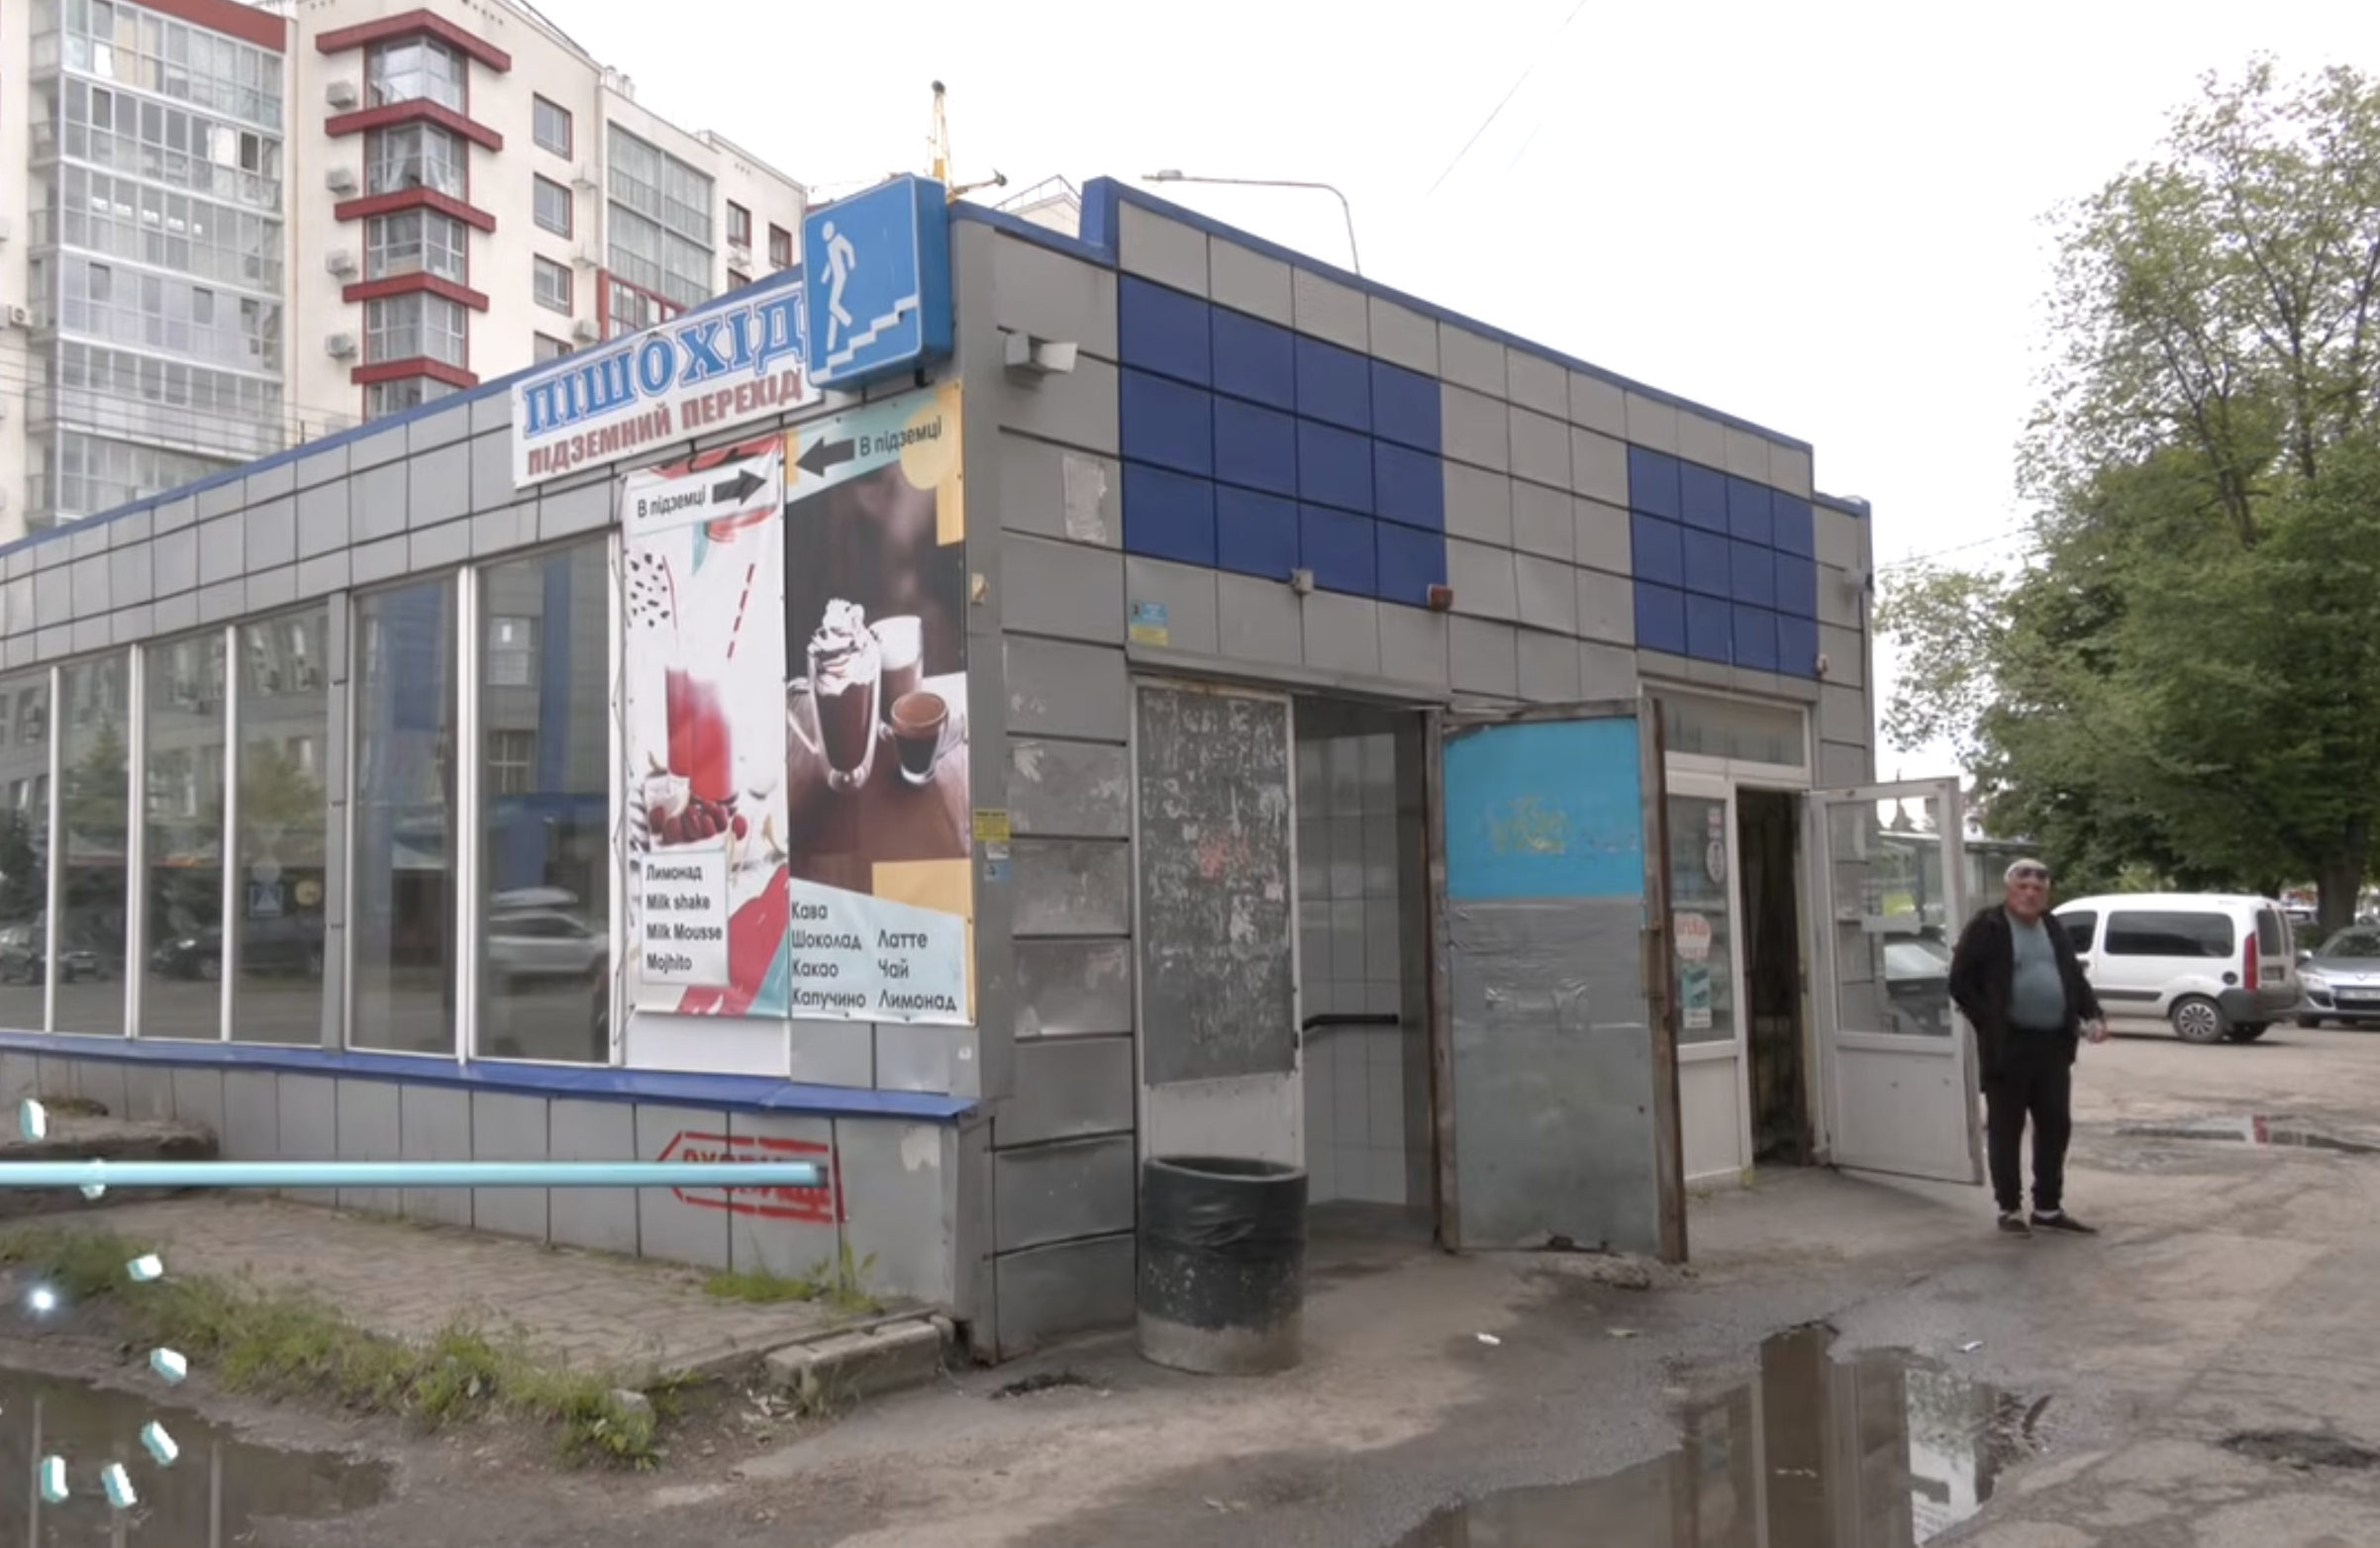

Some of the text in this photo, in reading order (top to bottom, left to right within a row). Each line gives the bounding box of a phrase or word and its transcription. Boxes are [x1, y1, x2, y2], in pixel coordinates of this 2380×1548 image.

[525, 293, 805, 435] ПІШОХІД
[528, 368, 803, 476] ПІДЗЕМНИЙ ПЕРЕХІД
[859, 415, 942, 456] В підземці
[637, 485, 707, 518] В підземці
[646, 863, 703, 882] Лимонад
[646, 893, 711, 911] Milk shake
[791, 902, 828, 920] Кава
[646, 922, 723, 941] Milk Mousse
[791, 929, 862, 951] Шоколад
[877, 928, 929, 949] Латте
[792, 958, 840, 978] Какао
[877, 958, 910, 979] Чай
[792, 987, 867, 1011] Капучино
[878, 989, 957, 1013] Лимонад
